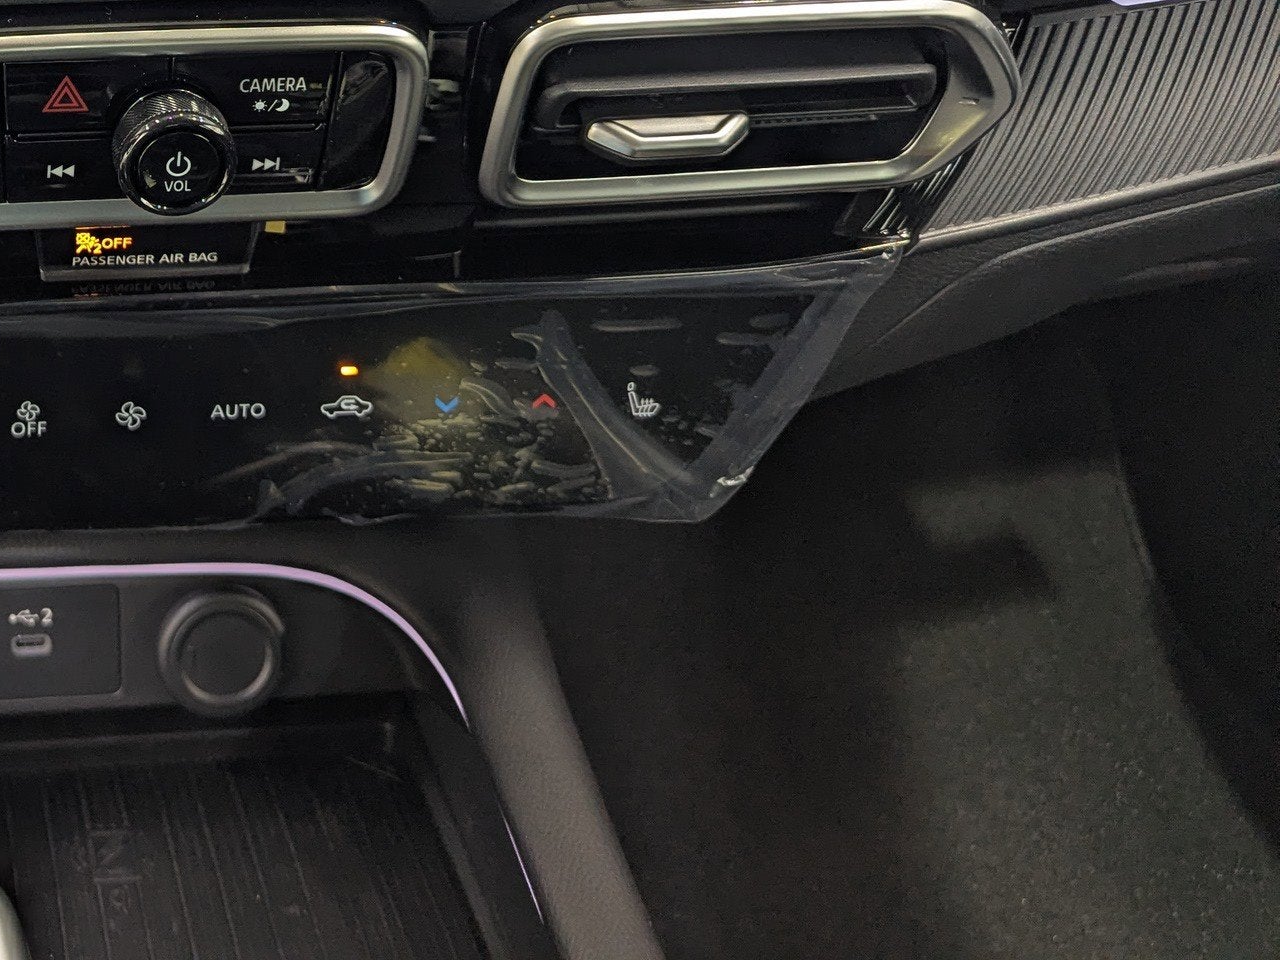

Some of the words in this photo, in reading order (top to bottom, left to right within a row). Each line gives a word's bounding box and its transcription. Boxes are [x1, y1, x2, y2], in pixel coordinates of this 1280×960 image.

[239, 76, 308, 94] CAMERA
[163, 179, 192, 193] VOL
[101, 237, 132, 250] OFF
[72, 254, 155, 266] PASSENGER
[159, 253, 184, 263] AIR
[188, 251, 219, 263] BAG
[210, 402, 266, 420] AUTO
[11, 421, 47, 438] OFF
[40, 607, 54, 628] 2
